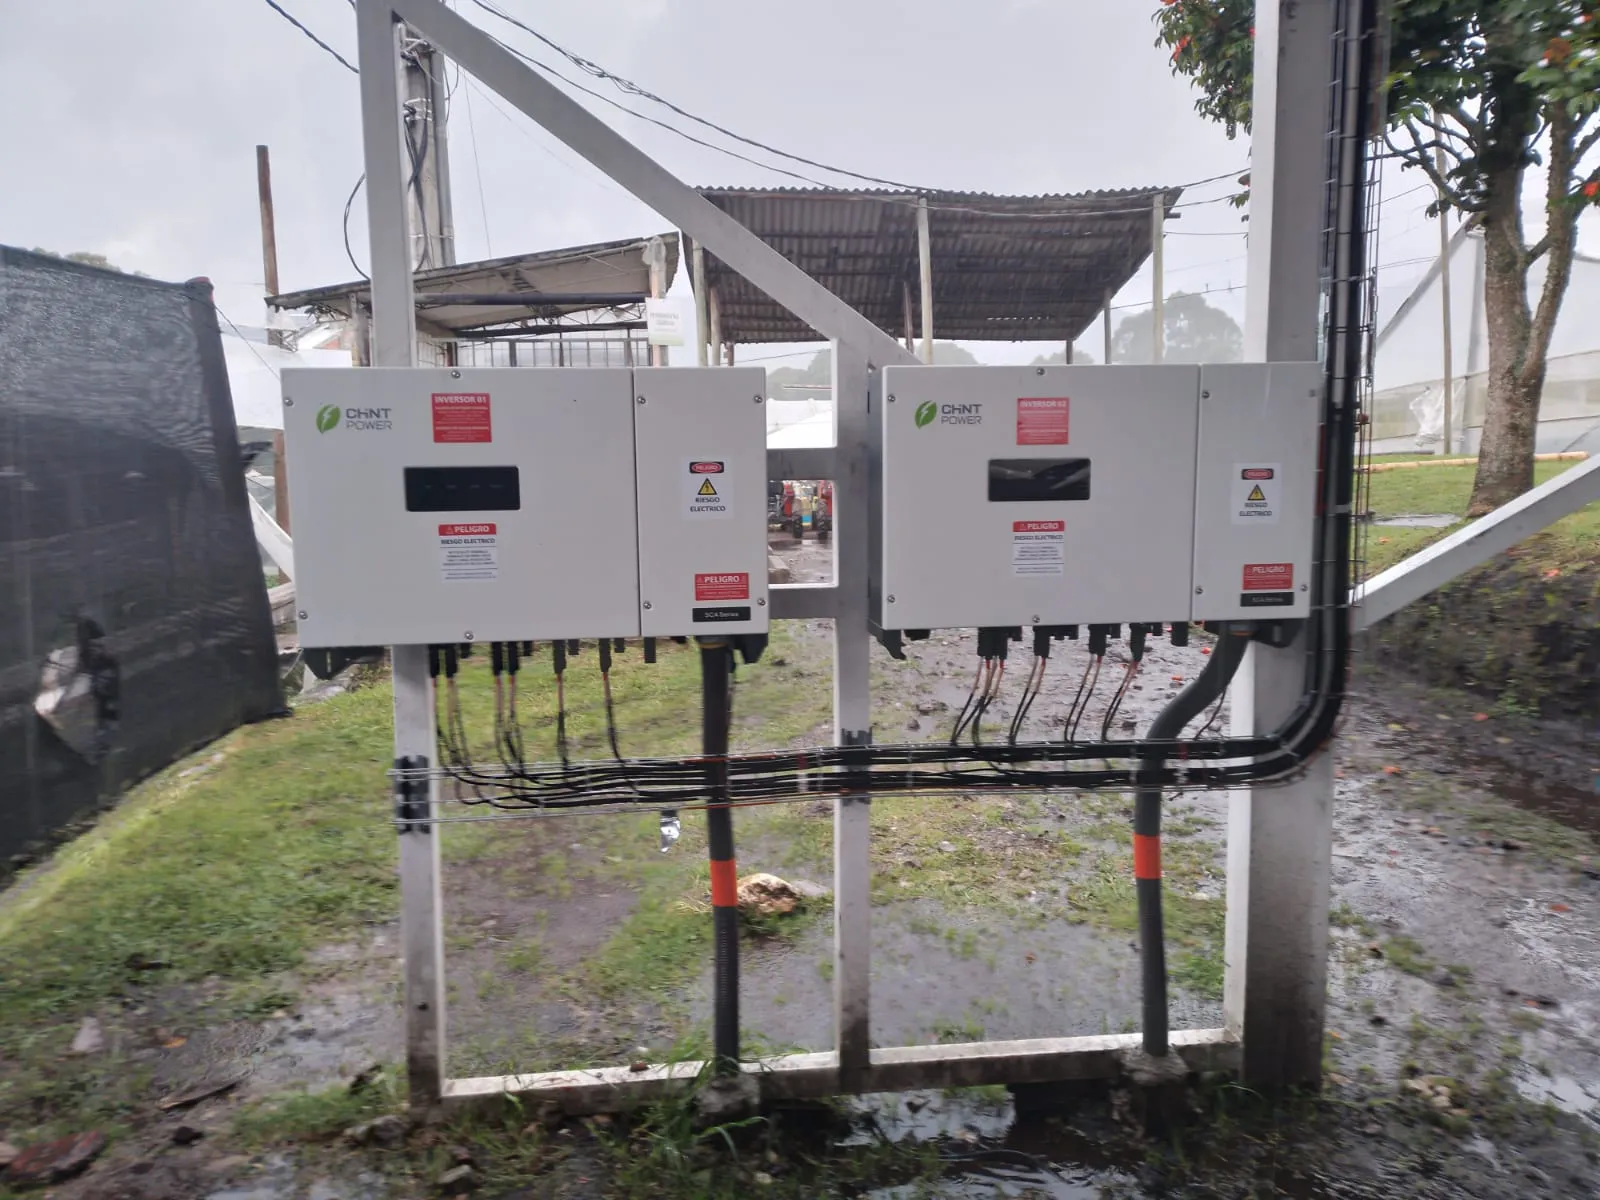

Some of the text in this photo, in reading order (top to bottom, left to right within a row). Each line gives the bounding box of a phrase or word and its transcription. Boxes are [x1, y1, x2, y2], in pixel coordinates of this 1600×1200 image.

[434, 395, 476, 404] INVERSOR
[941, 415, 982, 425] POWER
[346, 420, 392, 430] POWER
[454, 525, 490, 533] PELIGRO
[1027, 522, 1060, 530] PELIGRO
[1252, 566, 1285, 574] PELIGRO
[704, 575, 740, 583] PELIGRO
